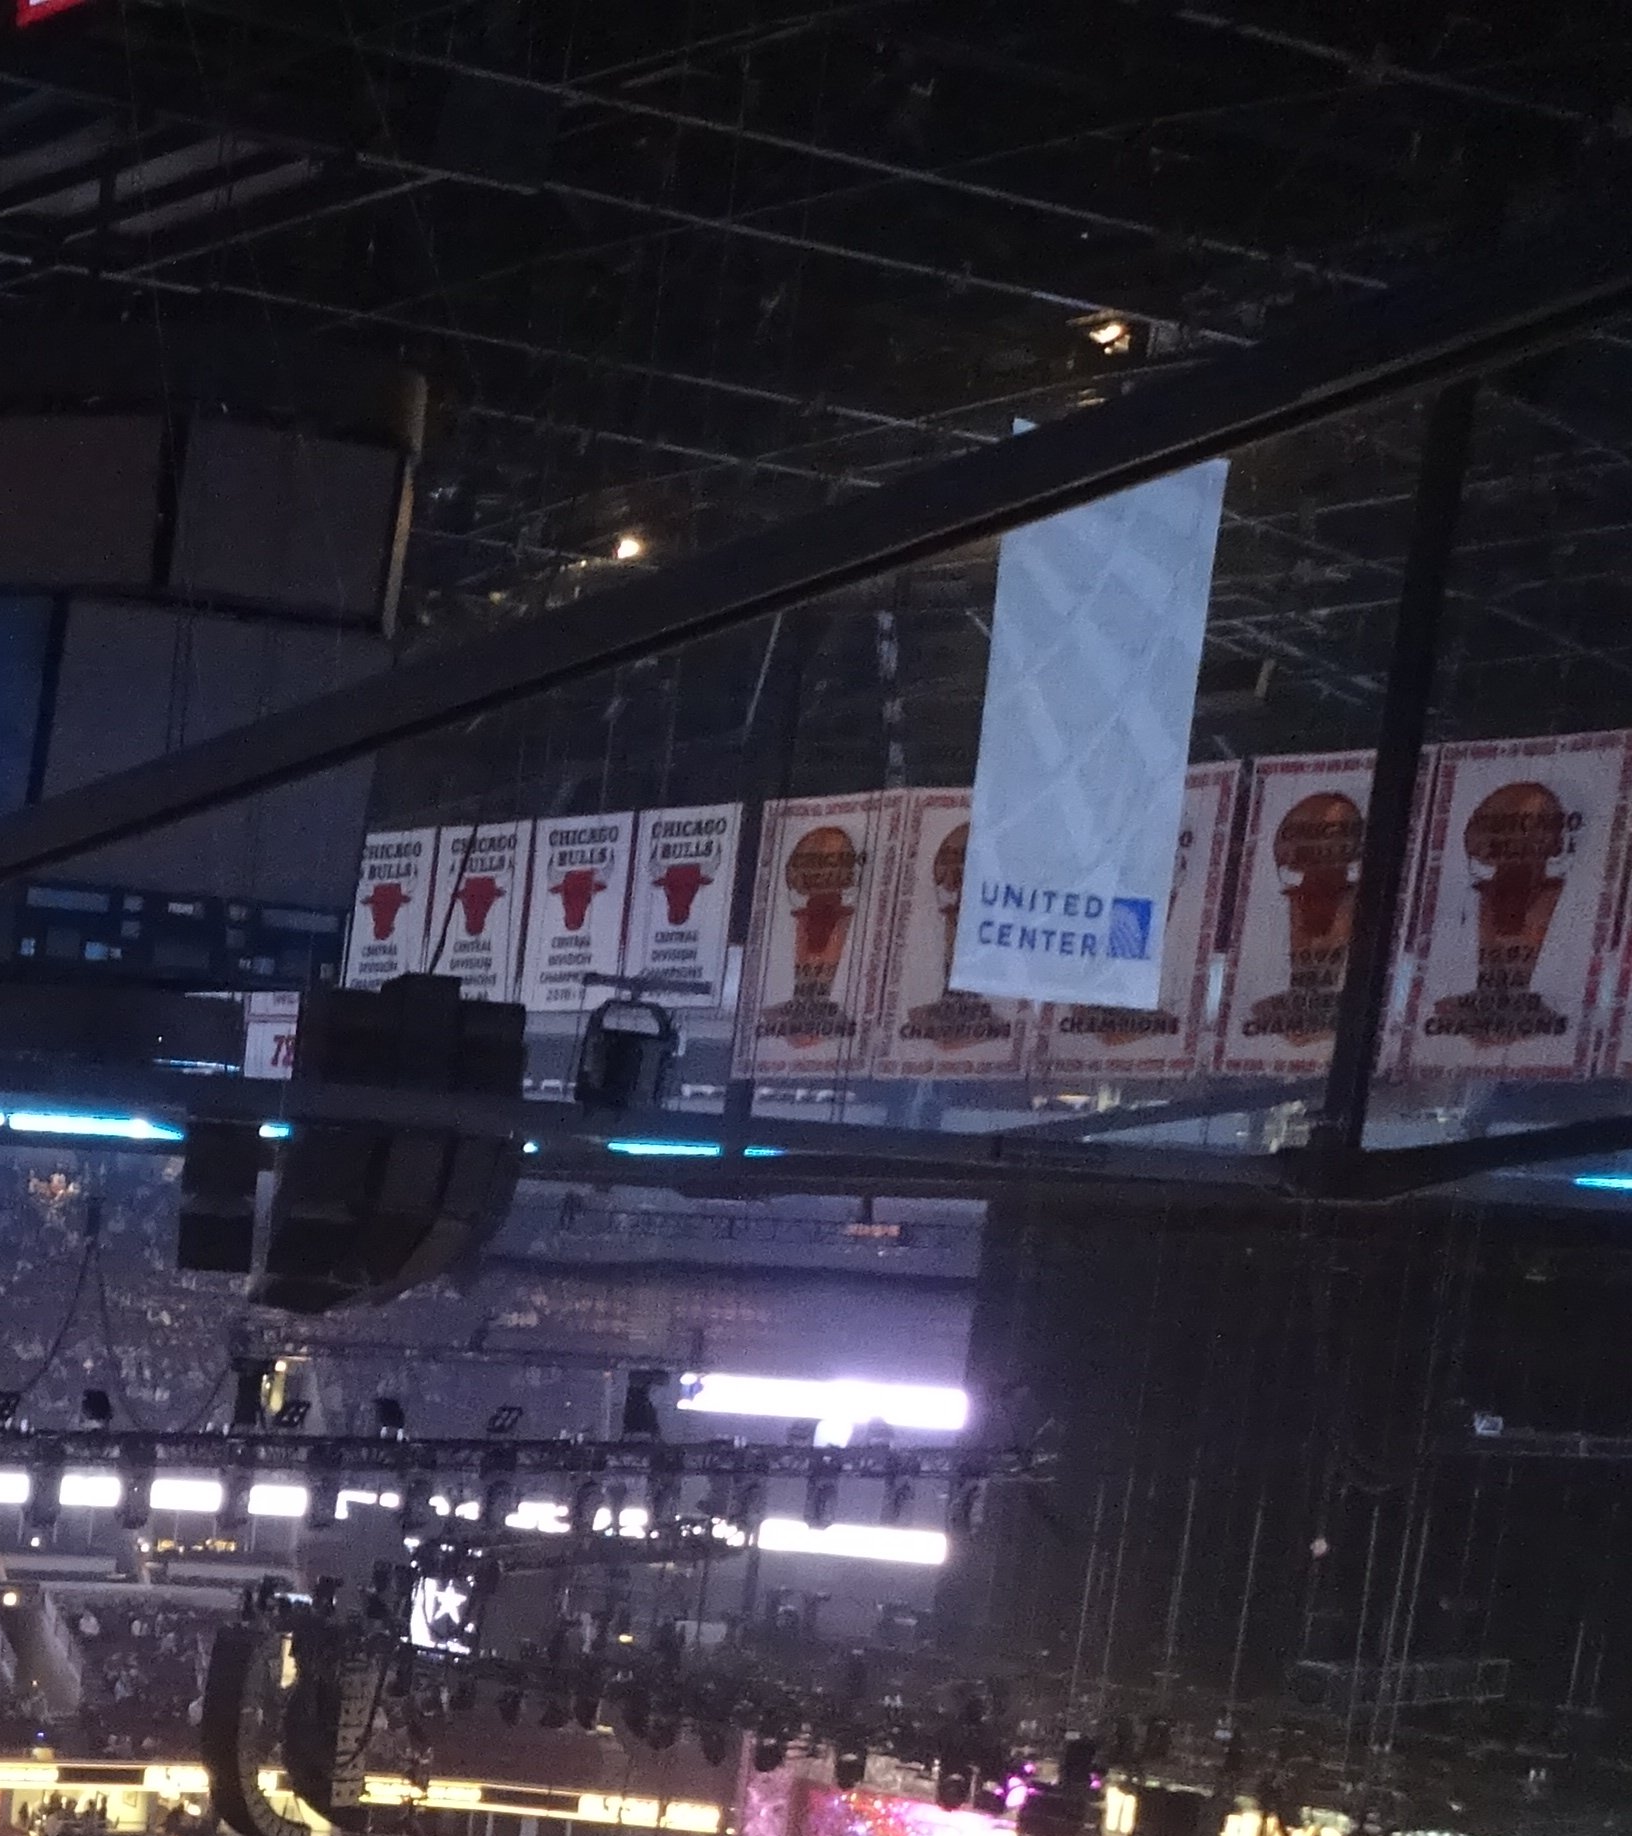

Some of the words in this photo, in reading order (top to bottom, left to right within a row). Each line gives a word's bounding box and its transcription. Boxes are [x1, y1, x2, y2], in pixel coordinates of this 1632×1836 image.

[549, 825, 619, 847] CHICAGO
[652, 817, 727, 838] CHICAGO
[558, 848, 607, 867] BULLS
[661, 840, 713, 859] BULLS
[367, 863, 411, 881] BULLS
[981, 881, 1104, 919] UNITED
[978, 920, 1097, 957] CENTER
